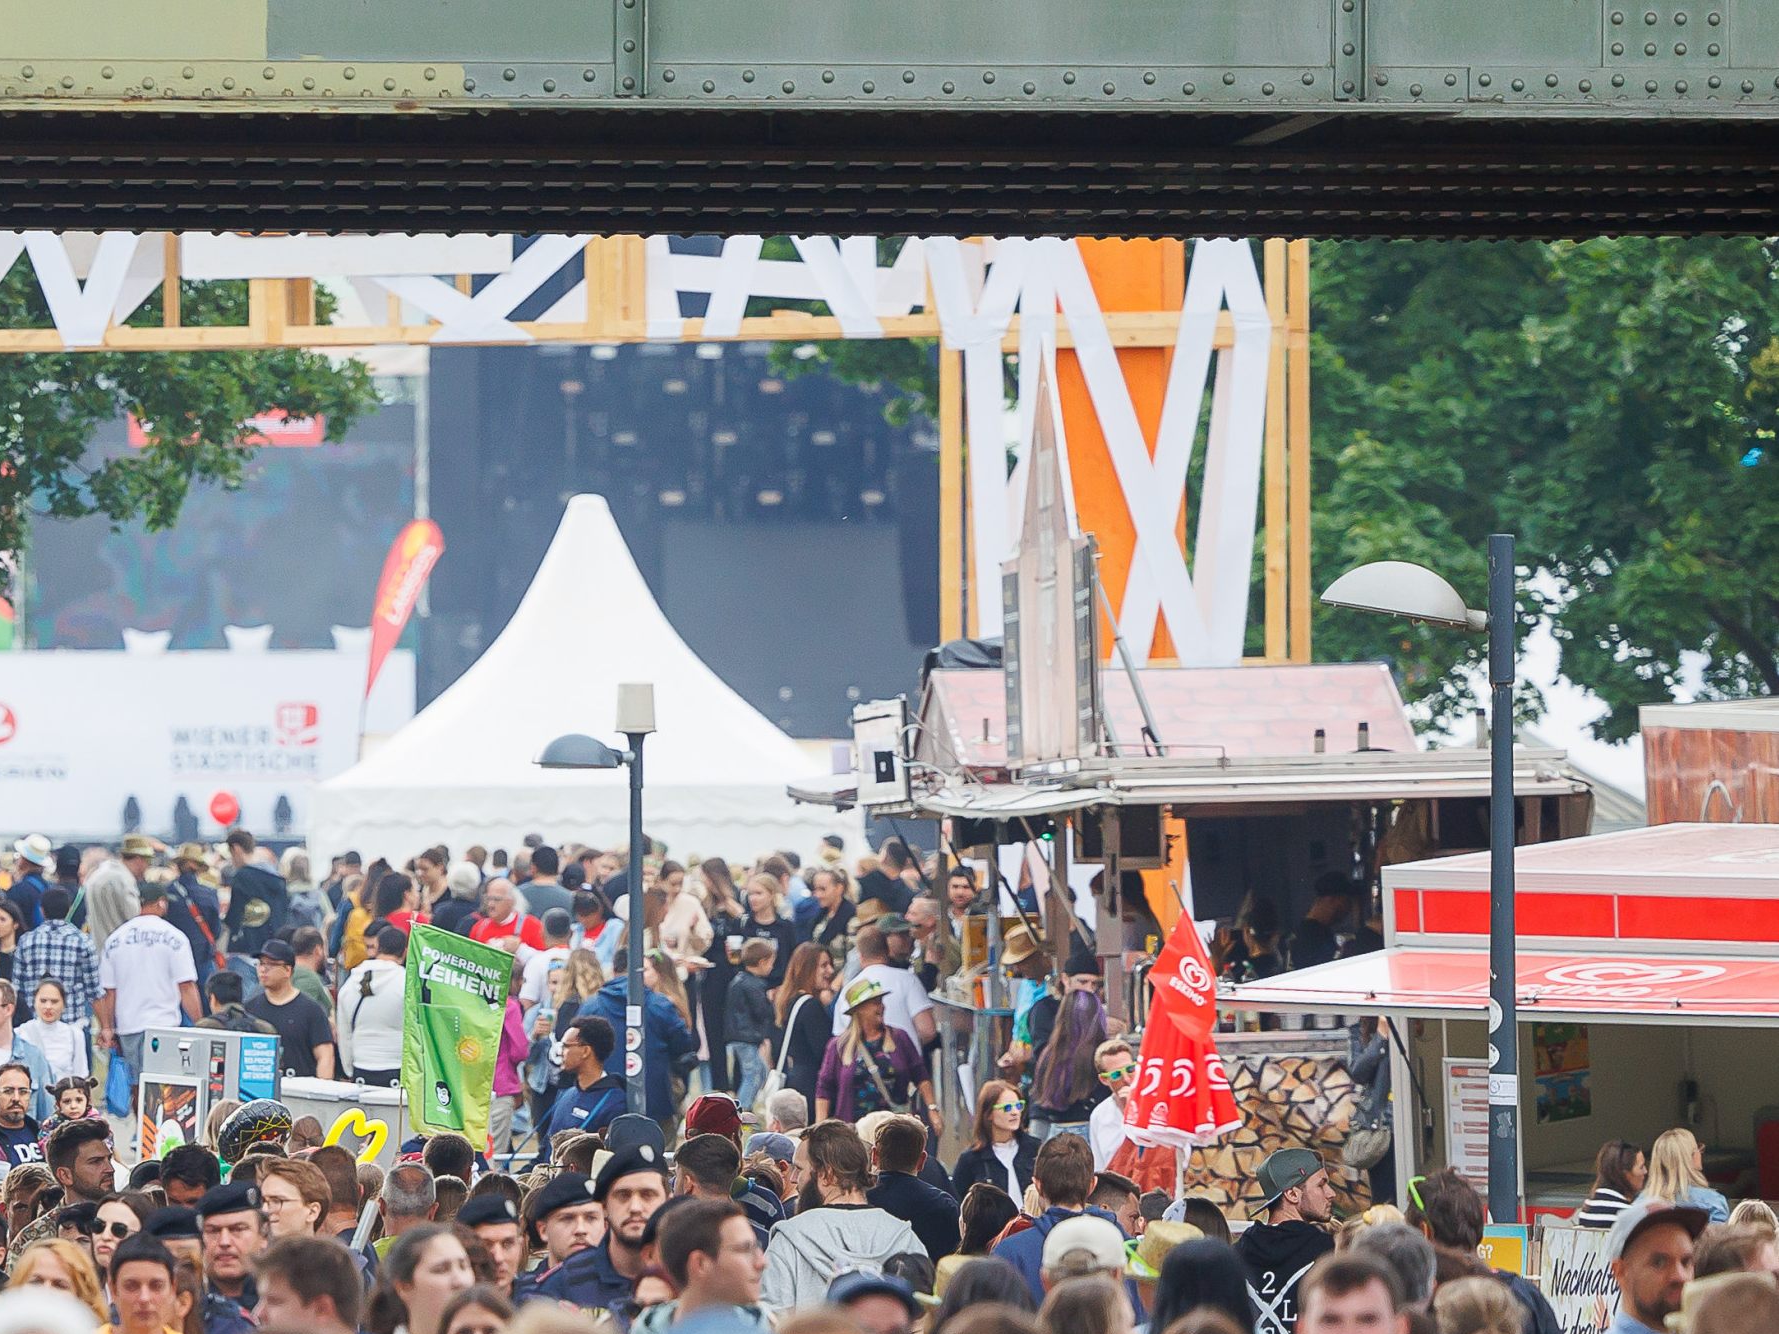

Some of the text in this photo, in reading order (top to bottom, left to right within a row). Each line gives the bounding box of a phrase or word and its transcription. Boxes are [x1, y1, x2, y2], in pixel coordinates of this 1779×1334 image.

[421, 945, 502, 980] POWERBANK
[418, 960, 500, 1001] LEIHEN!
[1169, 976, 1206, 1007] ESKIMO
